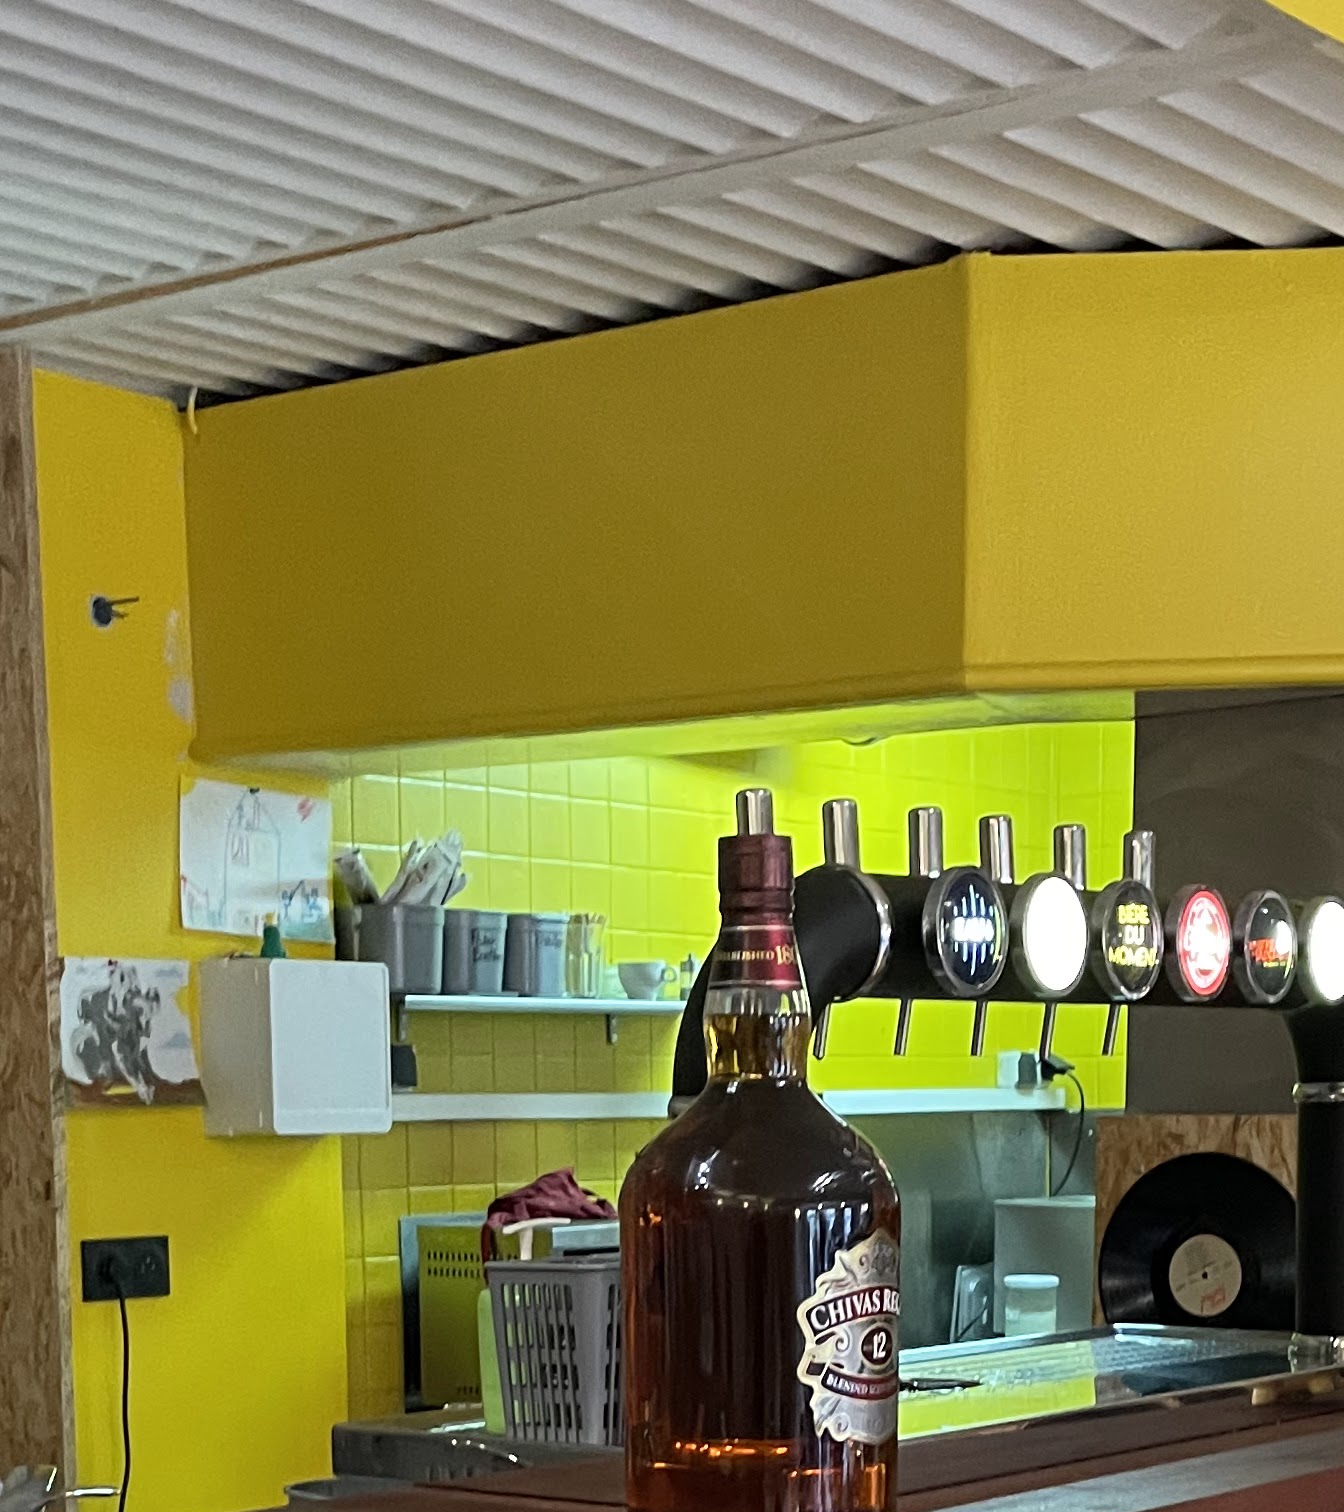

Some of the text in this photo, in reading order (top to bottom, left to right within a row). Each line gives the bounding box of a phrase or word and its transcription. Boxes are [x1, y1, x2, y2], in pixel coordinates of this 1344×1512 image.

[1125, 925, 1145, 945] DU
[809, 1289, 881, 1331] CHIVAS
[873, 1331, 887, 1360] 12
